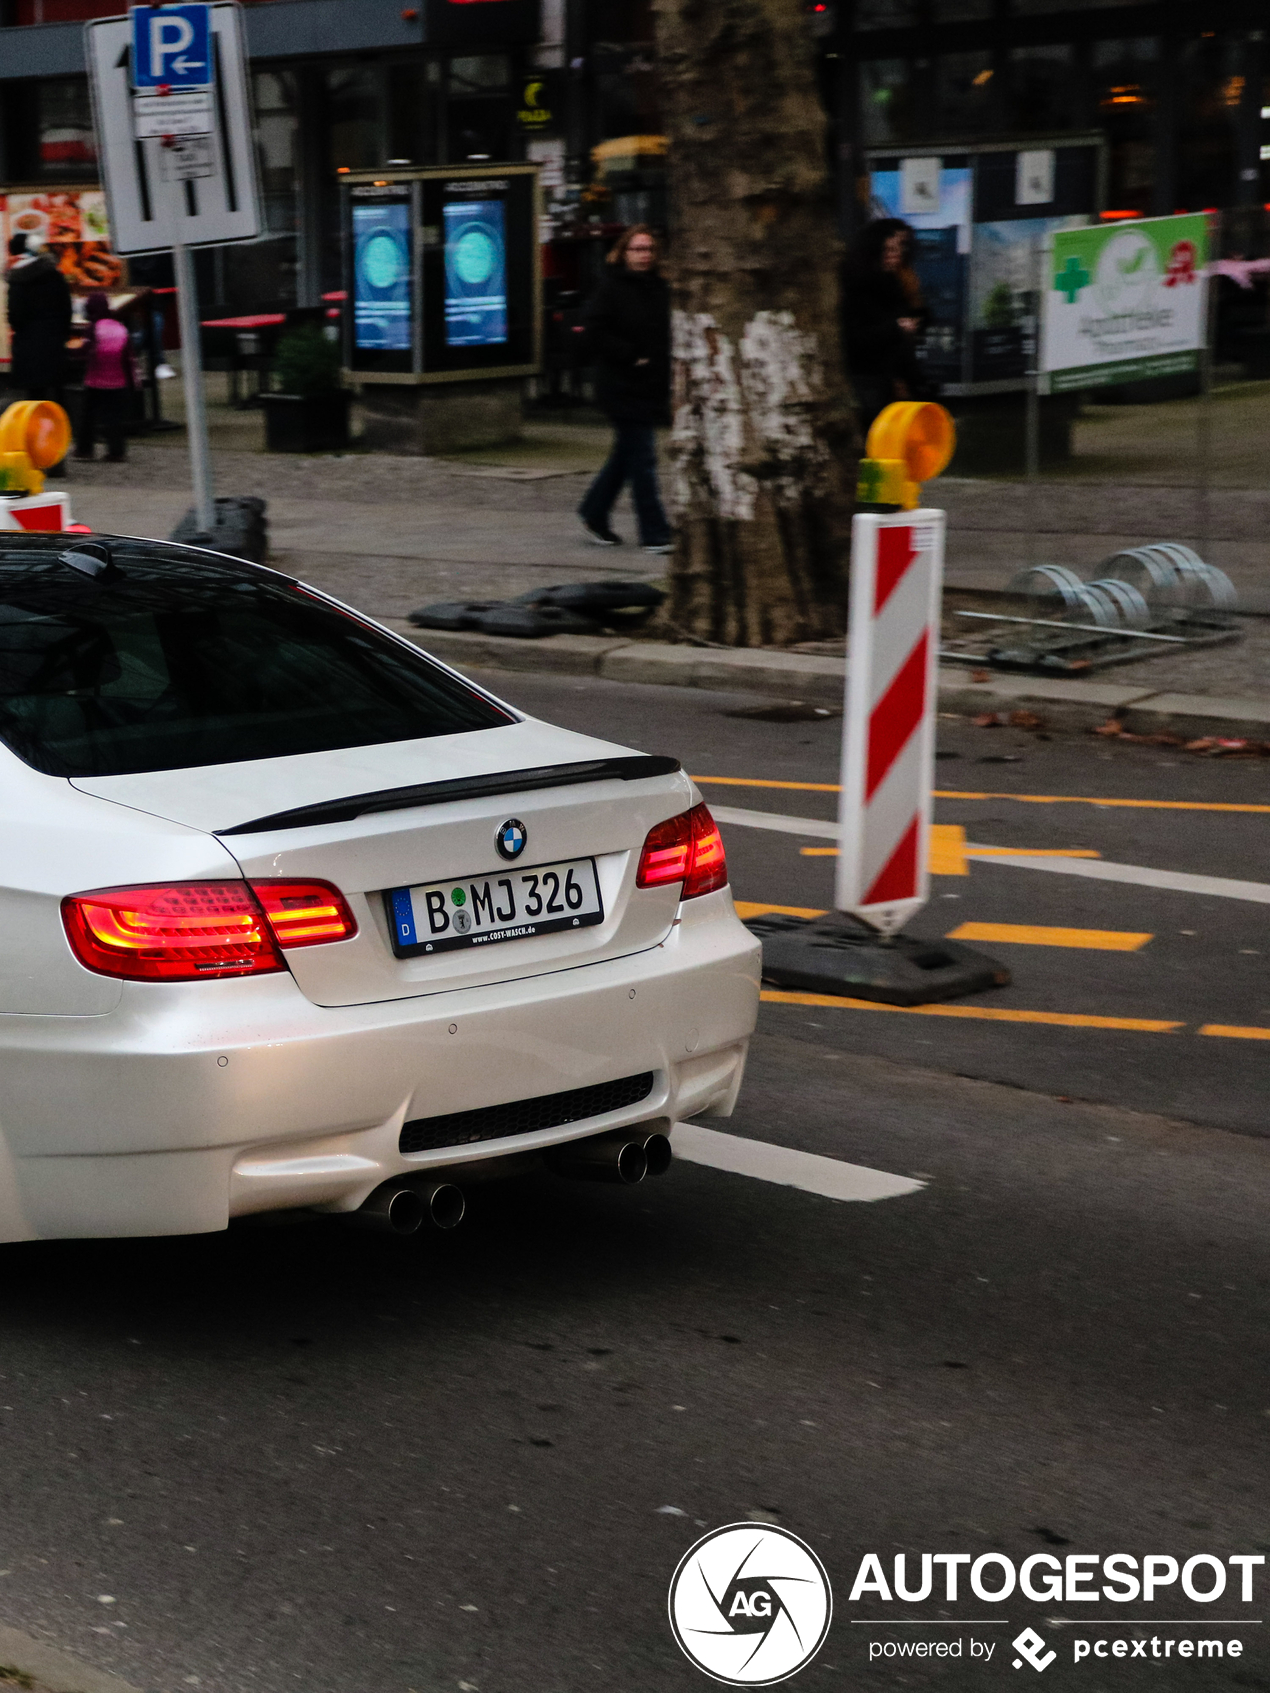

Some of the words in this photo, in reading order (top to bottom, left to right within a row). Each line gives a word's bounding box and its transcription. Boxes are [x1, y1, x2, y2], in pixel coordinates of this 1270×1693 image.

[149, 15, 194, 77] P
[425, 890, 450, 934] B
[470, 878, 516, 926] MJ
[522, 868, 583, 916] 326
[401, 924, 410, 937] D
[472, 926, 536, 944] www.COSY-WASCH.de
